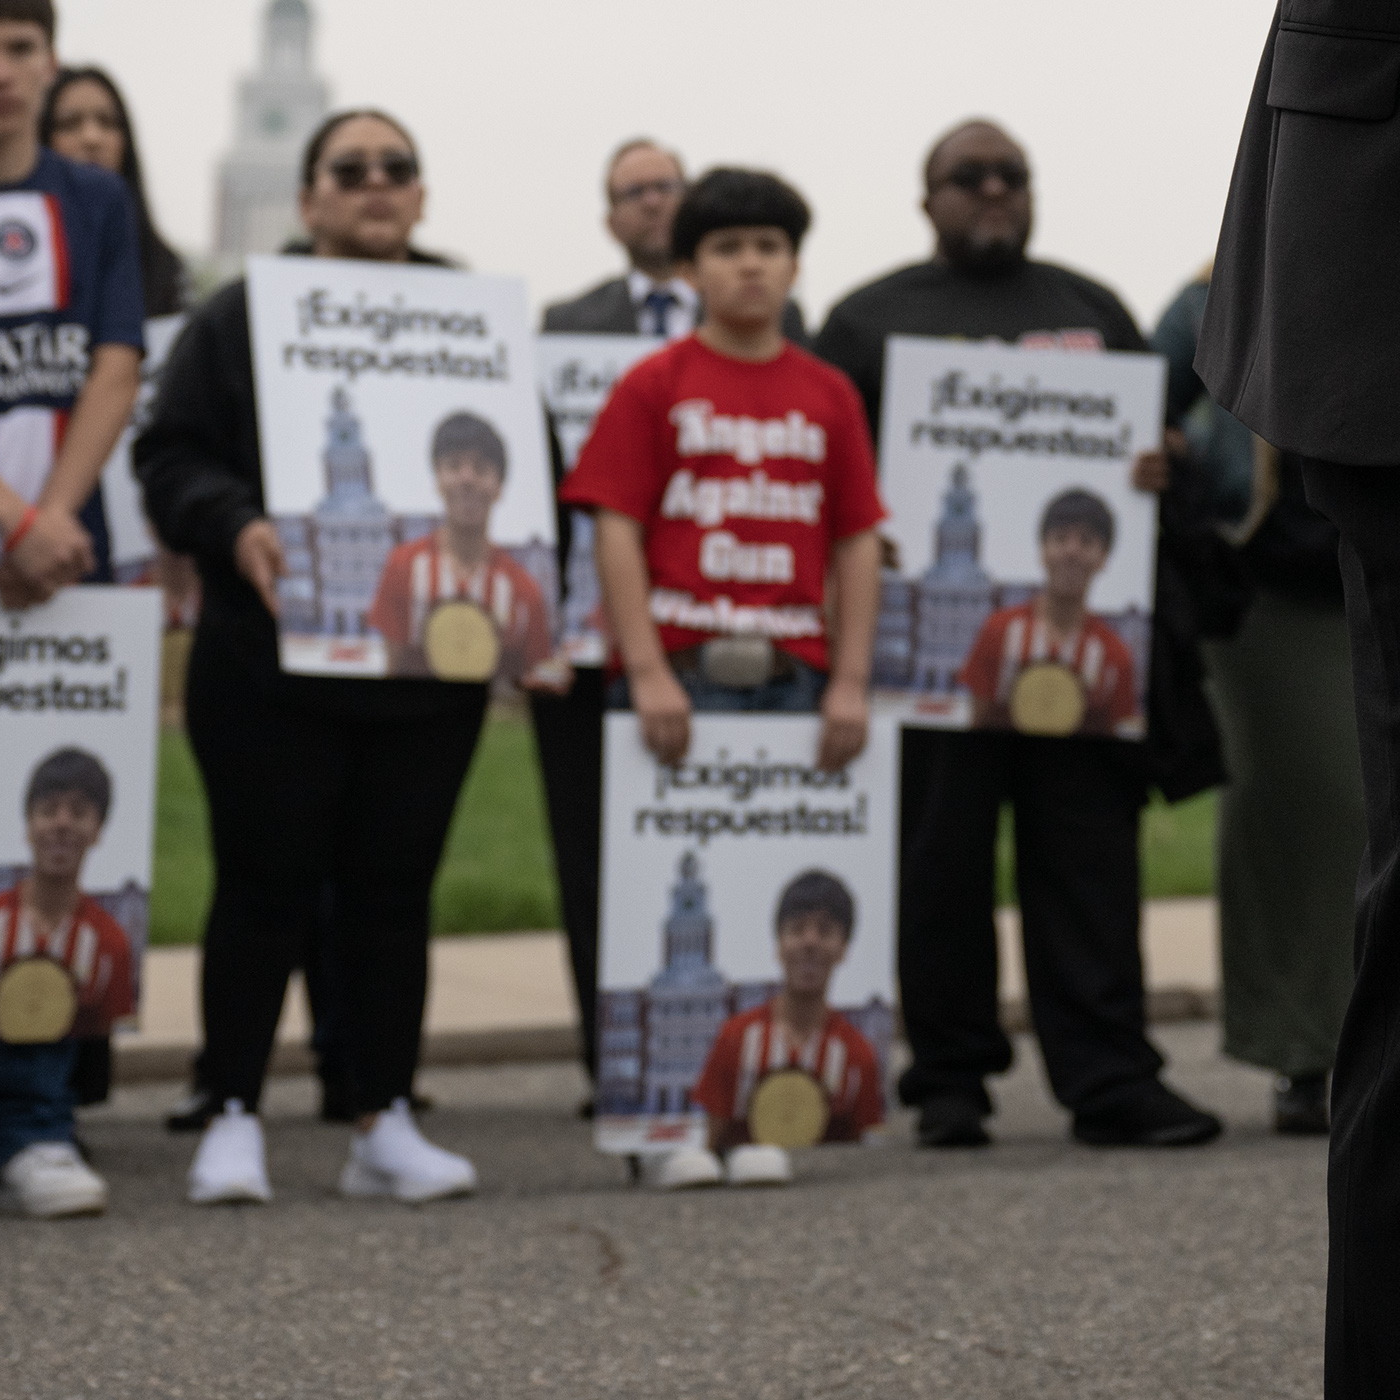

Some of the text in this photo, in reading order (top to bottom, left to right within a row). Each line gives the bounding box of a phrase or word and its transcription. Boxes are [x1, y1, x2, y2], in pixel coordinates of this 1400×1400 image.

[297, 287, 487, 343] ¡Exigimos
[283, 342, 510, 383] respuestas!
[931, 369, 1115, 422] ¡Exigimos
[667, 398, 828, 466] Angels
[910, 420, 1133, 460] respuestas!
[661, 467, 825, 526] Against
[701, 531, 795, 584] Gun
[635, 790, 868, 845] respuestas!
